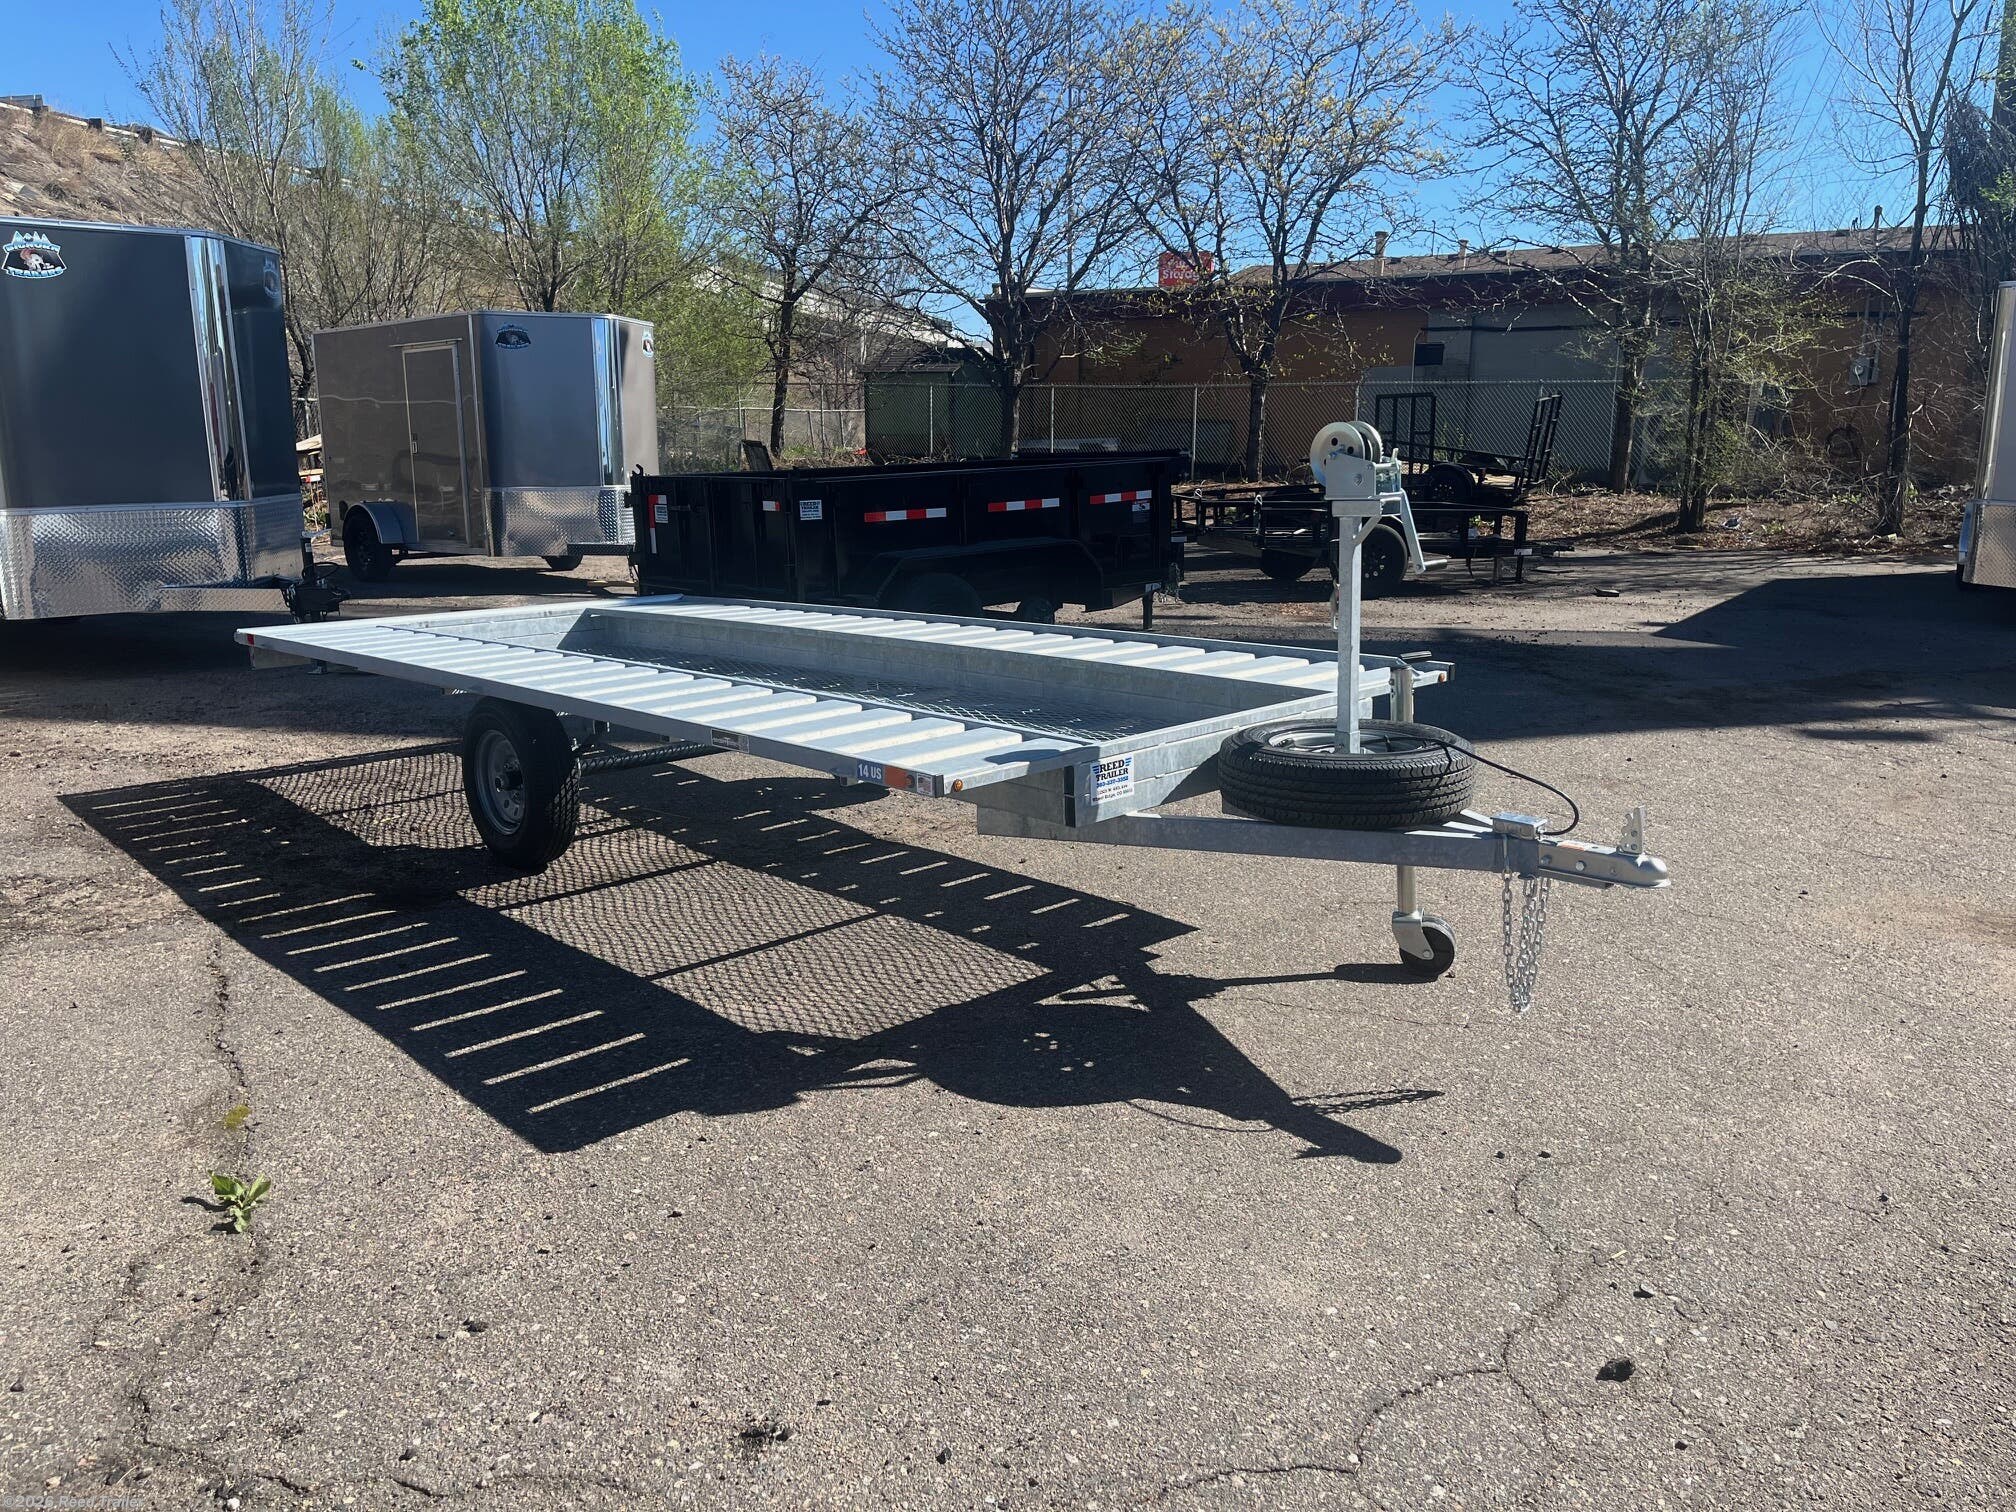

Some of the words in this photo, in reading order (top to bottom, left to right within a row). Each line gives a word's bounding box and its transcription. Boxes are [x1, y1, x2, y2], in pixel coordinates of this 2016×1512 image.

[7, 265, 63, 278] TRAILERS
[1162, 269, 1200, 281] Storag
[858, 763, 869, 777] 14
[870, 766, 882, 779] US
[1099, 760, 1125, 773] REED
[1095, 768, 1129, 782] TRAILER
